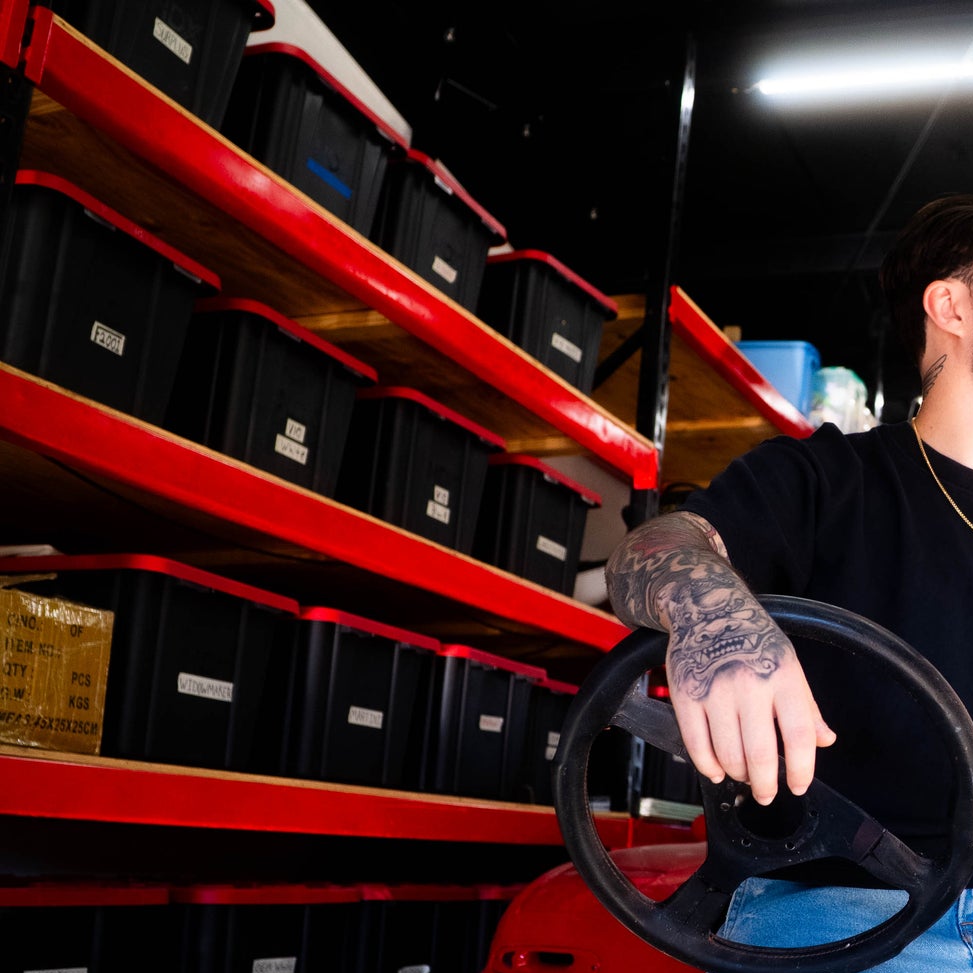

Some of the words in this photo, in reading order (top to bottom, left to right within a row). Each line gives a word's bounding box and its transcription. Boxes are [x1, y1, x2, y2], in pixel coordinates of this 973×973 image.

[69, 624, 84, 638] OF
[71, 671, 91, 687] PCS
[69, 695, 90, 710] KGS
